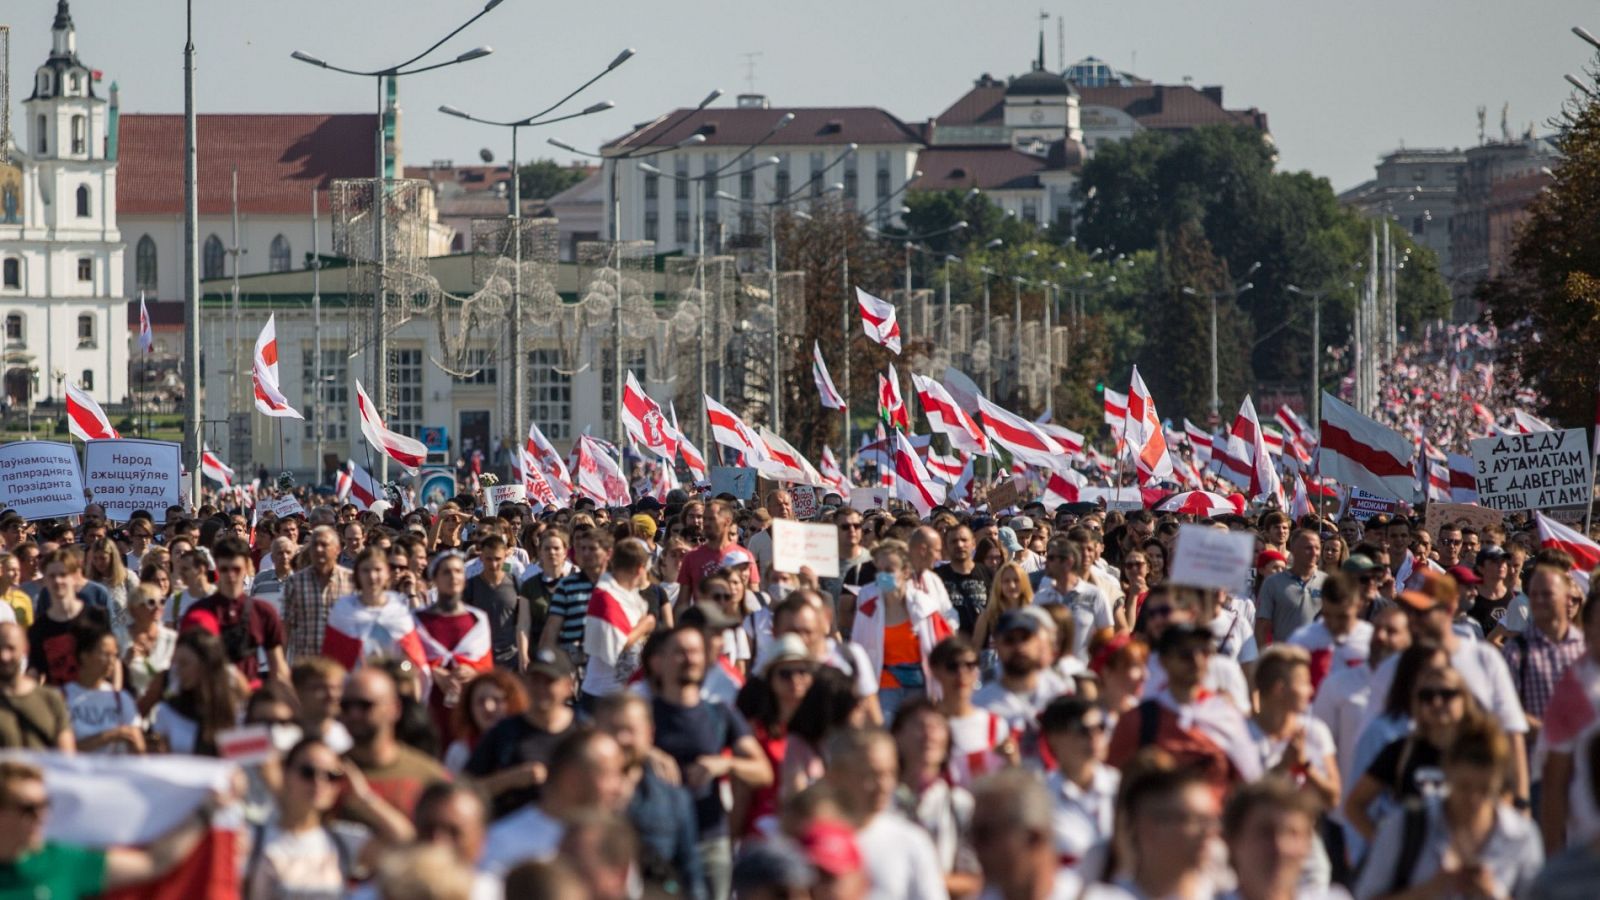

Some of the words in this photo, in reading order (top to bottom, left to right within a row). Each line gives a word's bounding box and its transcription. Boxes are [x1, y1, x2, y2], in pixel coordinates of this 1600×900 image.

[1492, 431, 1565, 455] ДЗЕДУ
[112, 454, 152, 467] Народ
[1478, 460, 1487, 474] З
[1493, 450, 1583, 474] АЎТАМАТАМ
[2, 468, 73, 482] папярэдняга
[91, 470, 169, 482] ажыццяўляе
[1477, 476, 1498, 494] НЕ
[1506, 468, 1586, 491] ДАВЕРЫМ
[8, 480, 72, 494] Прэзідэнта
[94, 486, 125, 494] сваю
[129, 483, 166, 497] ўладу
[1538, 486, 1588, 506] АТАМ!
